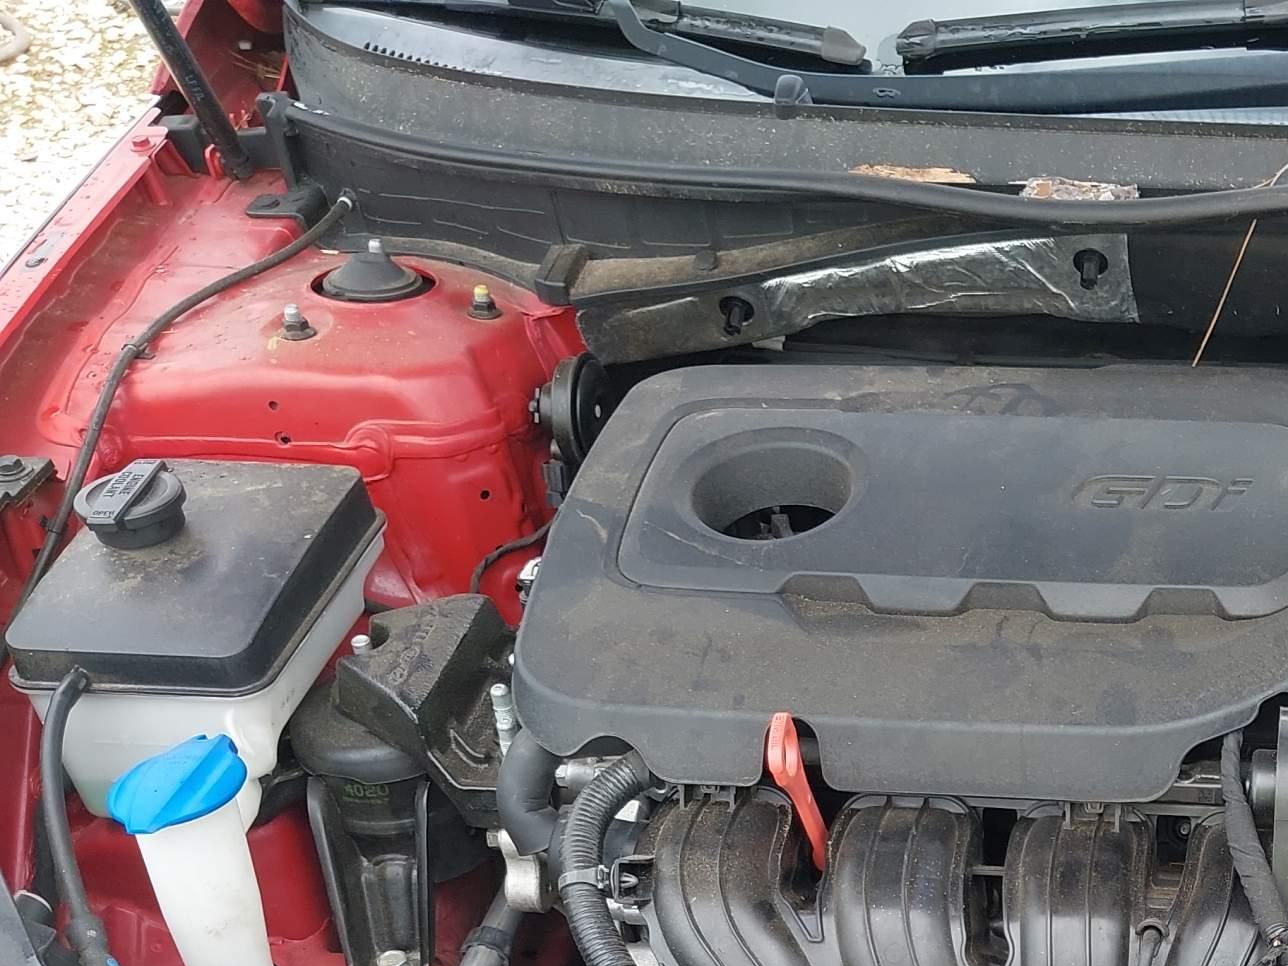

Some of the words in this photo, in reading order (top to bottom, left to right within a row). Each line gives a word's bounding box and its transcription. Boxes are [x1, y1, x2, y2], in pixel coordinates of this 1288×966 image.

[103, 471, 133, 498] COOLANT
[118, 473, 145, 496] ENGINE
[92, 509, 115, 517] OPEN
